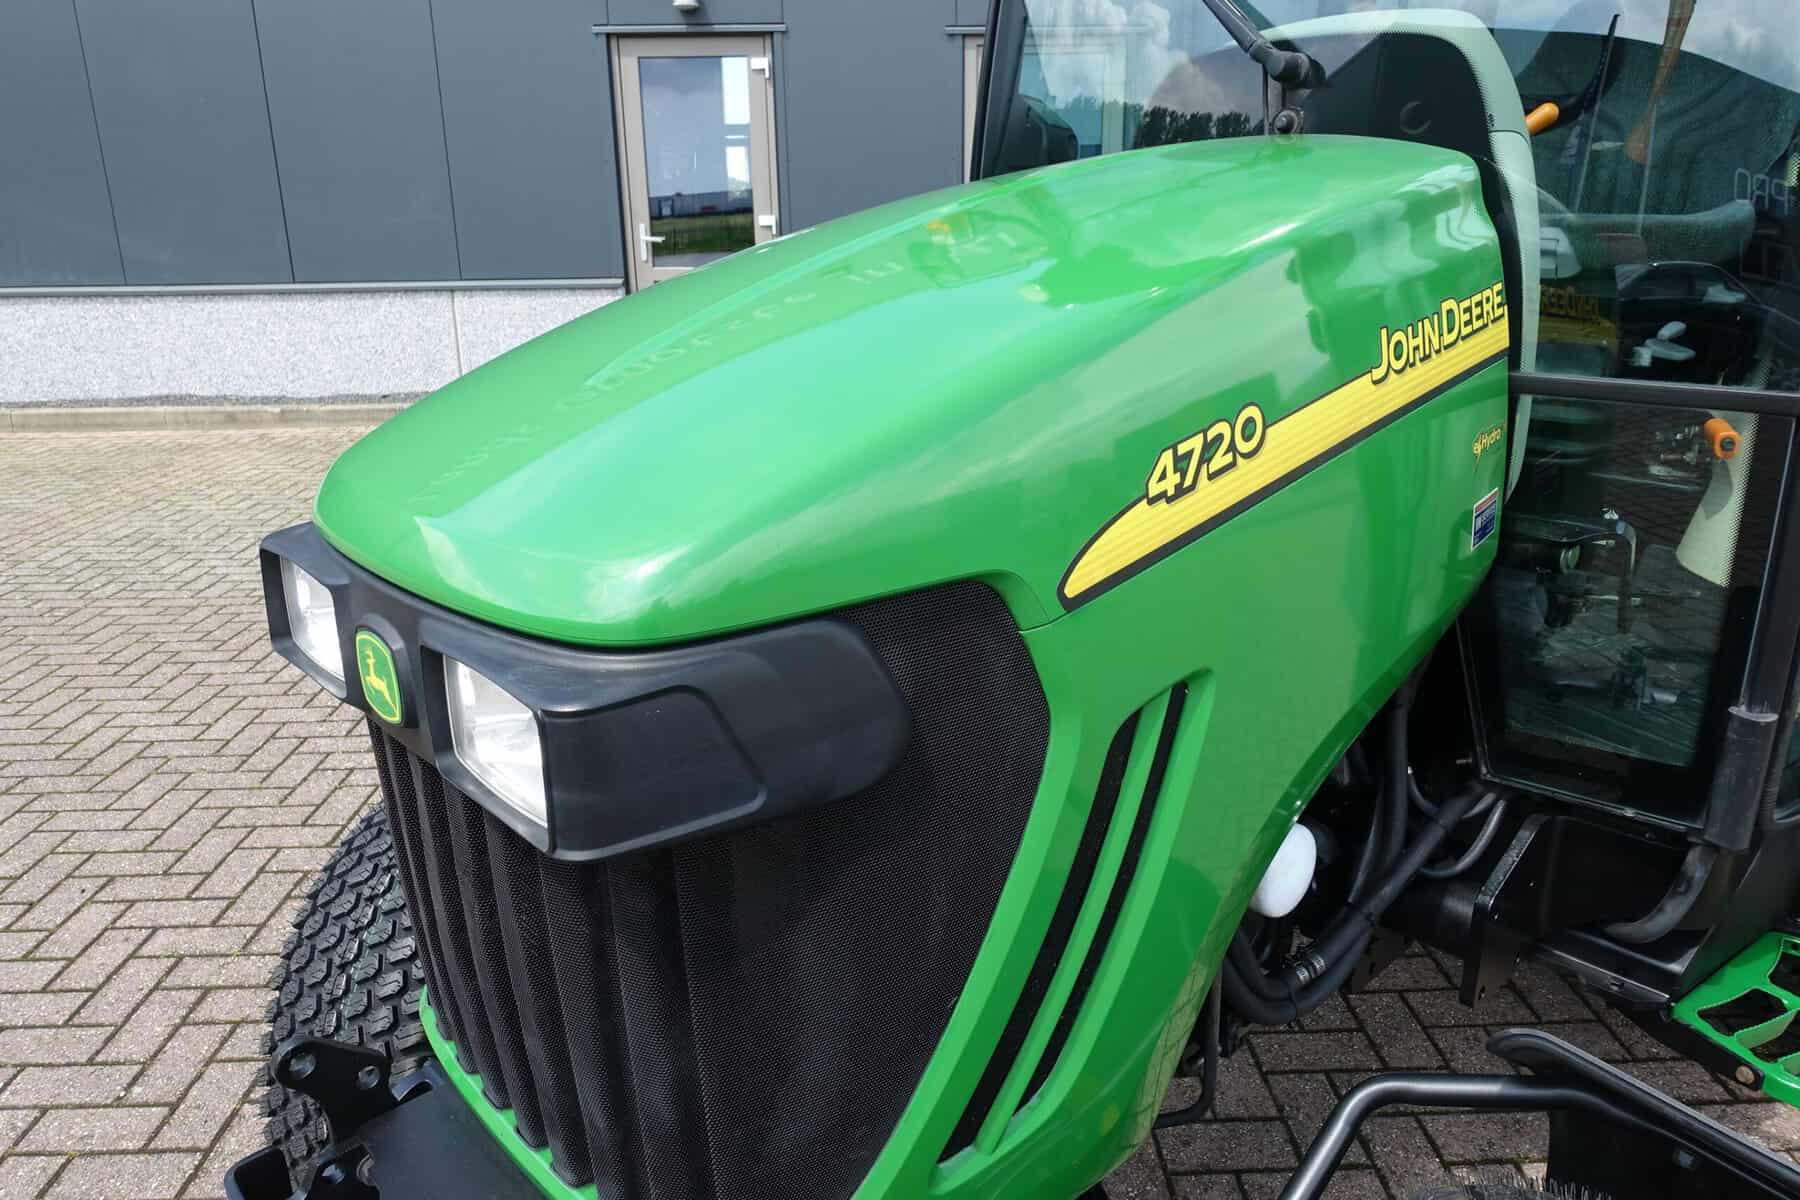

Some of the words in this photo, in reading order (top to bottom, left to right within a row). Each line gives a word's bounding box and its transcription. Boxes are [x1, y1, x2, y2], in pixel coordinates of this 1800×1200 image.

[1371, 312, 1441, 385] JOHN
[1440, 282, 1505, 349] DEERE
[1146, 402, 1265, 505] 4720
